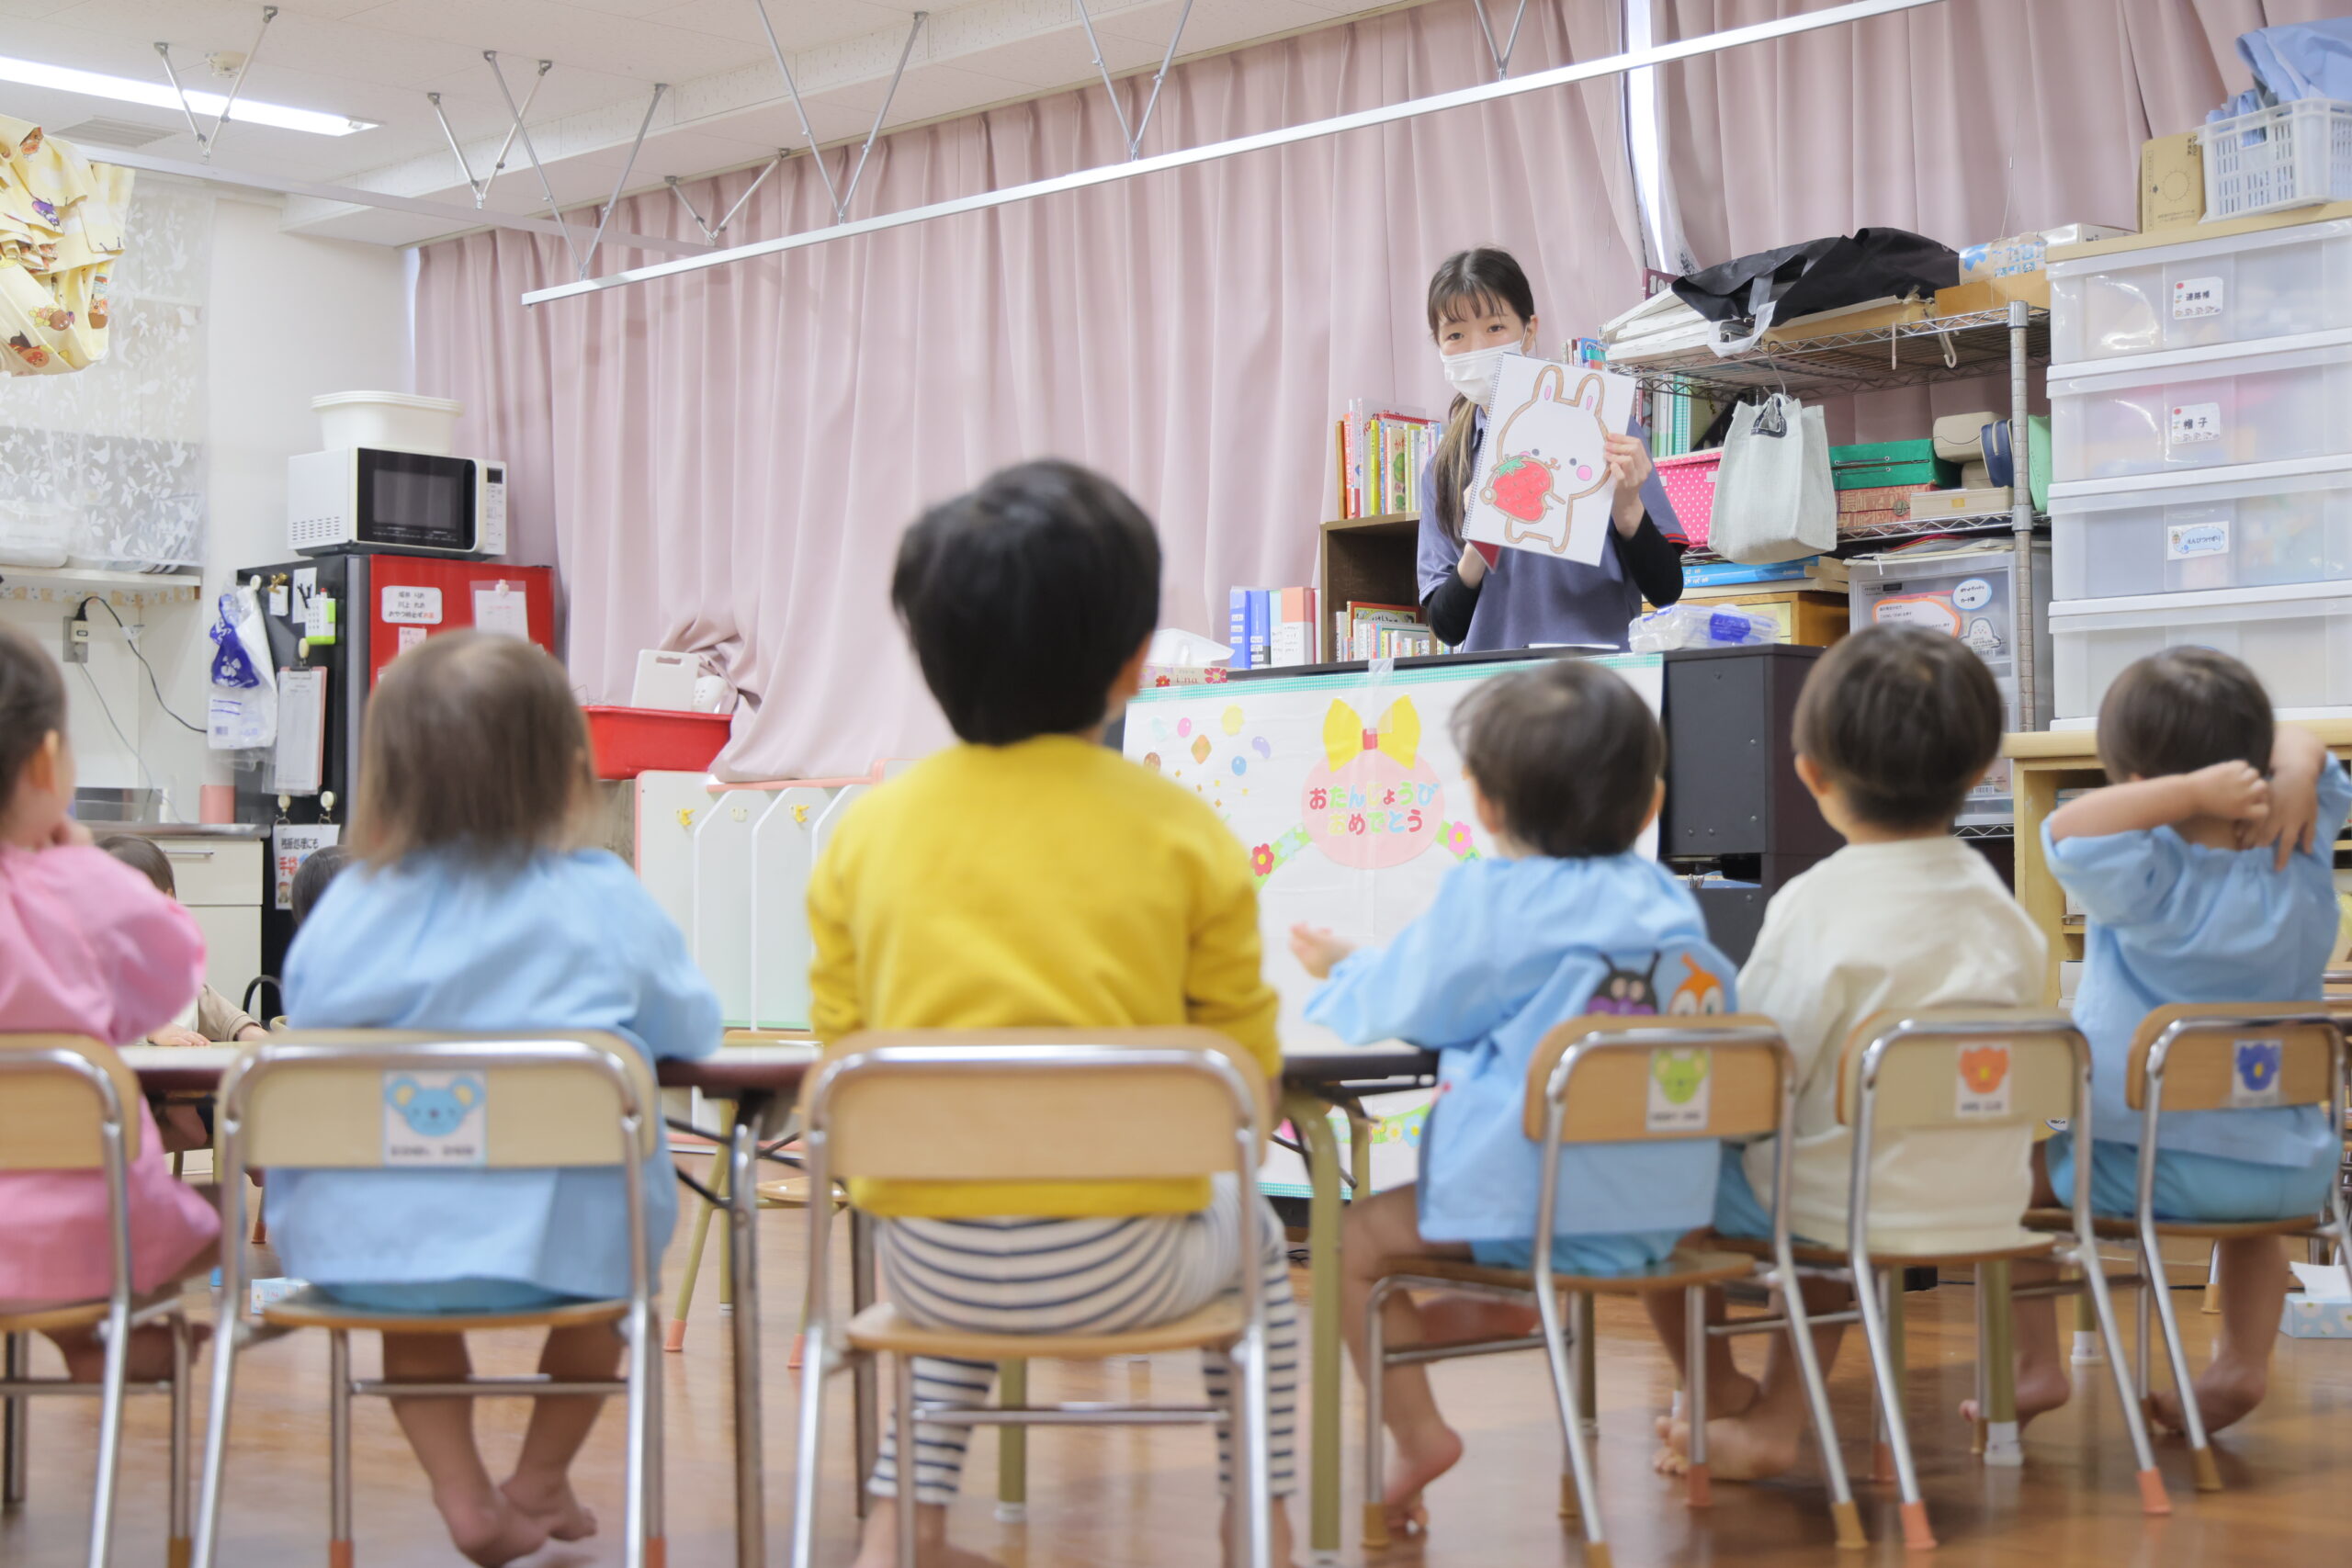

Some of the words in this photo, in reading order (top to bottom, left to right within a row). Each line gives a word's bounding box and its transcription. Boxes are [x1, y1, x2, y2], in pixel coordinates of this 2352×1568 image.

[1309, 781, 1440, 809] おたんじょうび
[1328, 809, 1423, 835] おめでとう
